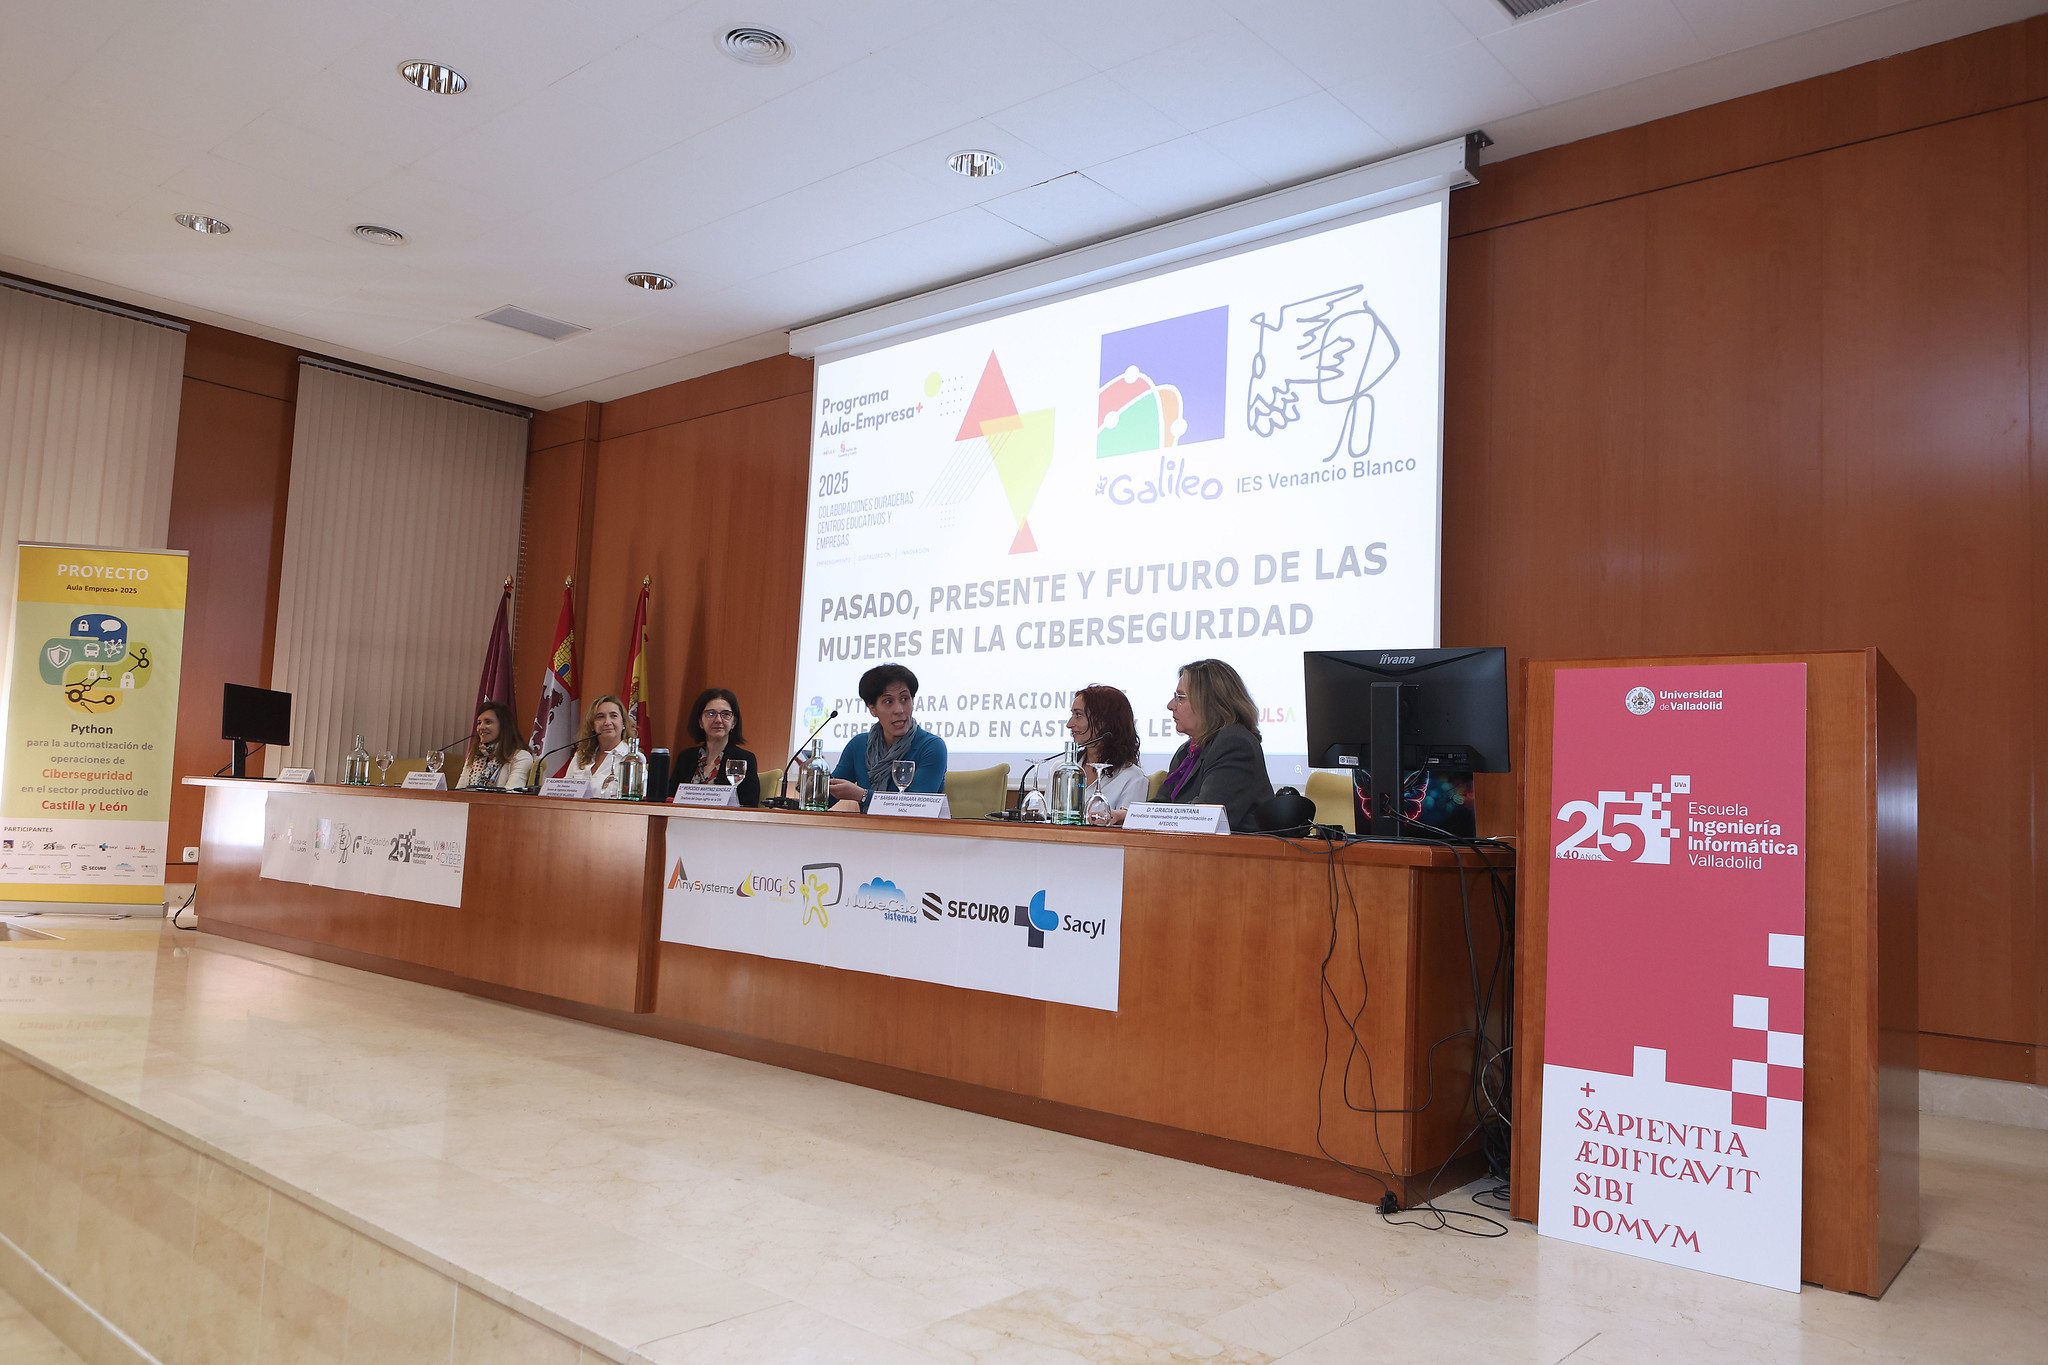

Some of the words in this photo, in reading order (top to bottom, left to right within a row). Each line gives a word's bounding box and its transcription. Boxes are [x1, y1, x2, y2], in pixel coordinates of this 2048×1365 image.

[822, 389, 889, 415] Programa
[819, 471, 849, 497] 2025
[1108, 456, 1223, 505] Galileo
[1236, 475, 1263, 494] IES
[1268, 464, 1347, 490] Venancio
[1352, 457, 1416, 479] Blanco
[818, 498, 873, 519] COLABORACIONES
[874, 491, 914, 509] DURADERAS
[817, 518, 845, 534] CENTROS
[846, 512, 886, 530] EDUCATIVOS
[886, 511, 892, 523] Y
[816, 533, 850, 550] EMPRESAS
[57, 564, 149, 581] PROYECTO
[820, 589, 920, 623] PASADO,
[929, 573, 1066, 613] PRESENTE
[1077, 571, 1096, 600] Y
[1106, 556, 1240, 598] FUTURO
[1254, 551, 1300, 585] DE
[1315, 541, 1387, 581] LAS
[818, 630, 922, 662] MUJERES
[931, 627, 963, 655] EN
[973, 624, 1006, 653] LA
[1015, 603, 1314, 650] CIBERSEGURIDAD
[1379, 654, 1416, 665] iiyama
[834, 698, 868, 714] PYT
[914, 694, 949, 712] ARA
[957, 691, 1074, 711] OPERACION
[1659, 690, 1723, 700] Universidad
[1659, 702, 1670, 711] de
[1670, 701, 1723, 711] Valladolid
[71, 723, 113, 735] Python
[988, 720, 1017, 738] EN
[1020, 719, 1069, 738] CAST
[1149, 718, 1177, 737] LE
[27, 740, 49, 748] para
[52, 739, 60, 747] la
[63, 740, 139, 750] automatización
[141, 742, 153, 750] de
[51, 755, 110, 765] operaciones
[113, 756, 125, 765] de
[42, 769, 133, 781] Ciberseguridad
[37, 785, 46, 793] el
[48, 787, 78, 795] sector
[81, 787, 134, 796] productivo
[137, 788, 149, 796] de
[42, 800, 85, 811] Castilla
[89, 802, 96, 812] y
[99, 801, 128, 812] León
[1688, 801, 1748, 817] Escuela
[1556, 800, 1646, 862] 25
[1688, 817, 1782, 837] Ingeniería
[363, 846, 373, 855] UVa
[364, 836, 389, 847] Fundación
[388, 836, 409, 862] 25
[1688, 835, 1799, 856] Informática
[413, 852, 433, 860] Informática
[1563, 850, 1580, 860] 40
[1580, 851, 1603, 861] AÑOS
[1688, 853, 1763, 870] Valladolid
[674, 879, 734, 895] AnySystems
[884, 911, 918, 924] sistemas
[1063, 914, 1106, 940] Sacyl
[1575, 1107, 1749, 1158] SAPIENTIA
[1575, 1140, 1761, 1194] ÆDIFICAVIT
[1573, 1172, 1633, 1205] SIBI
[1572, 1205, 1701, 1253] DOMVM
